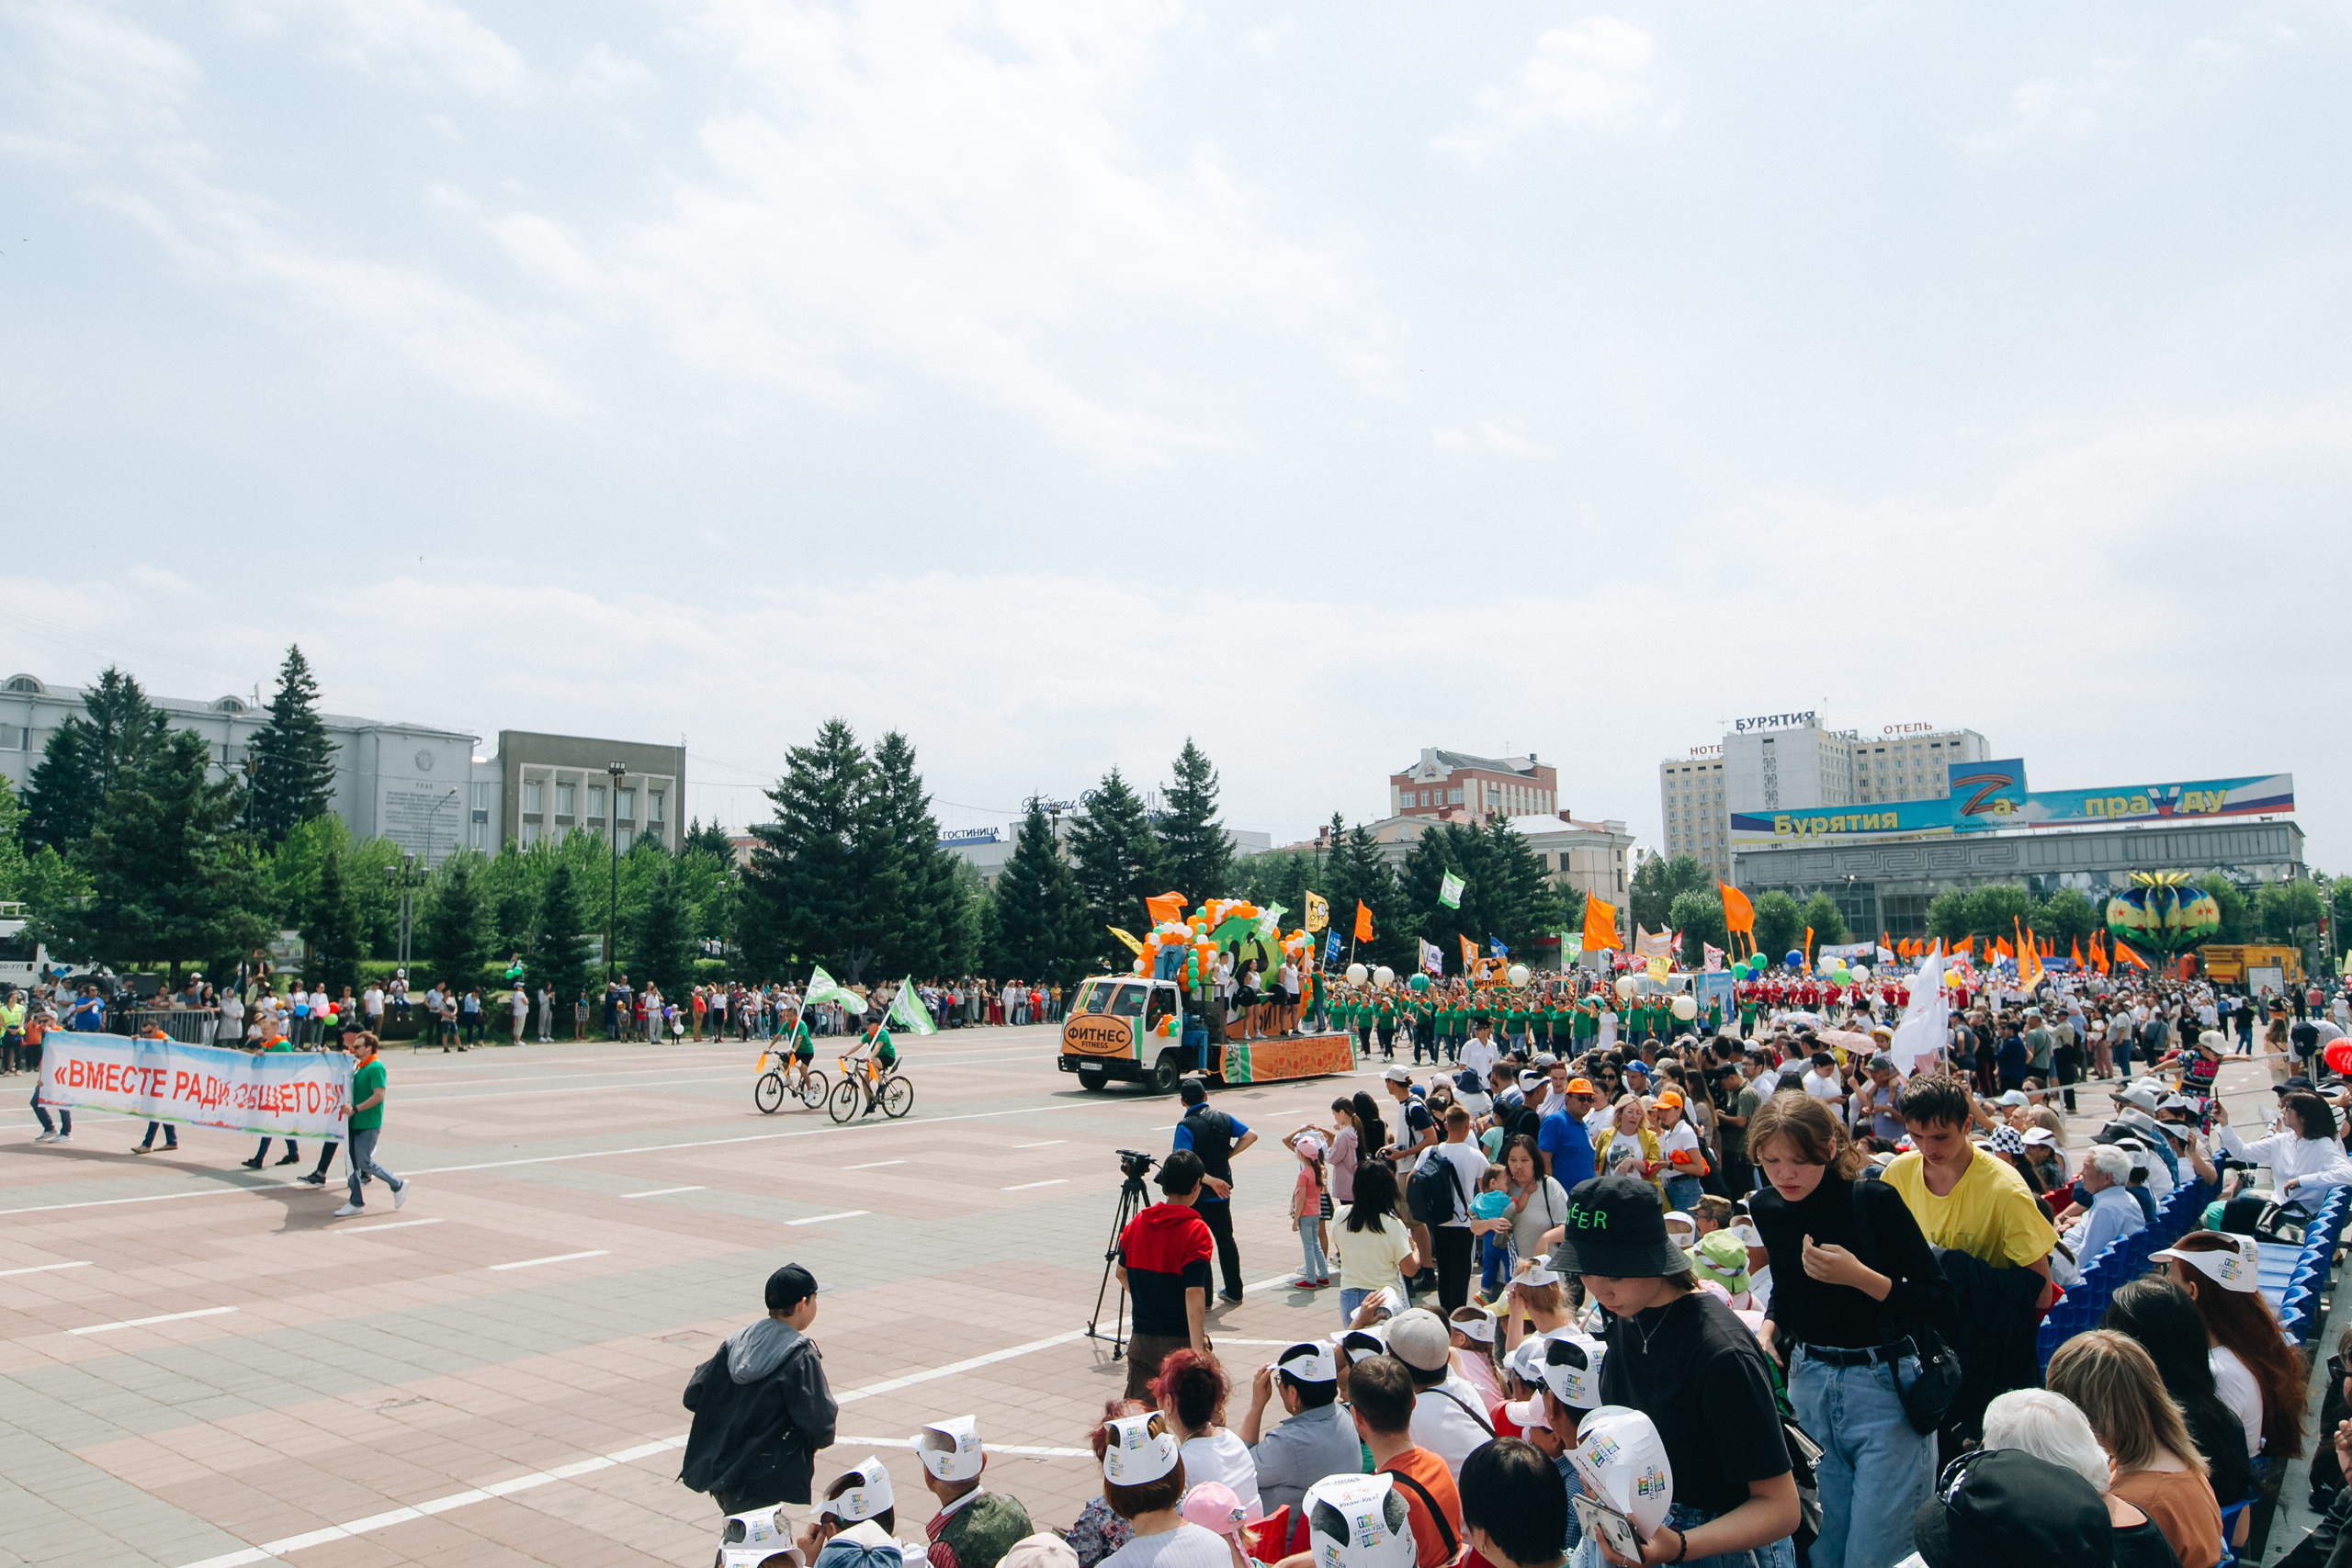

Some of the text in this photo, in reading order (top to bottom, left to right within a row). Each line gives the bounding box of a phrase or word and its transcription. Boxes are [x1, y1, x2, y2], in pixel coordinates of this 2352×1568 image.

[1736, 711, 1815, 731] БУРЯТИЯ
[1884, 722, 1932, 734] ОТЕЛЬ
[1690, 744, 1724, 755] HOTE
[1773, 811, 1899, 839] Бурятия
[943, 827, 1000, 840] ГОСТИНИЦА
[1474, 979, 1507, 987] ФИТНЕС
[1069, 1027, 1125, 1043] ФИТНЕС
[1081, 1041, 1108, 1049] FITNESS
[54, 1059, 166, 1099] «ВМЕСТЕ
[173, 1071, 232, 1111] РАДИ
[1353, 1523, 1385, 1537] УЛАН-УДЭ
